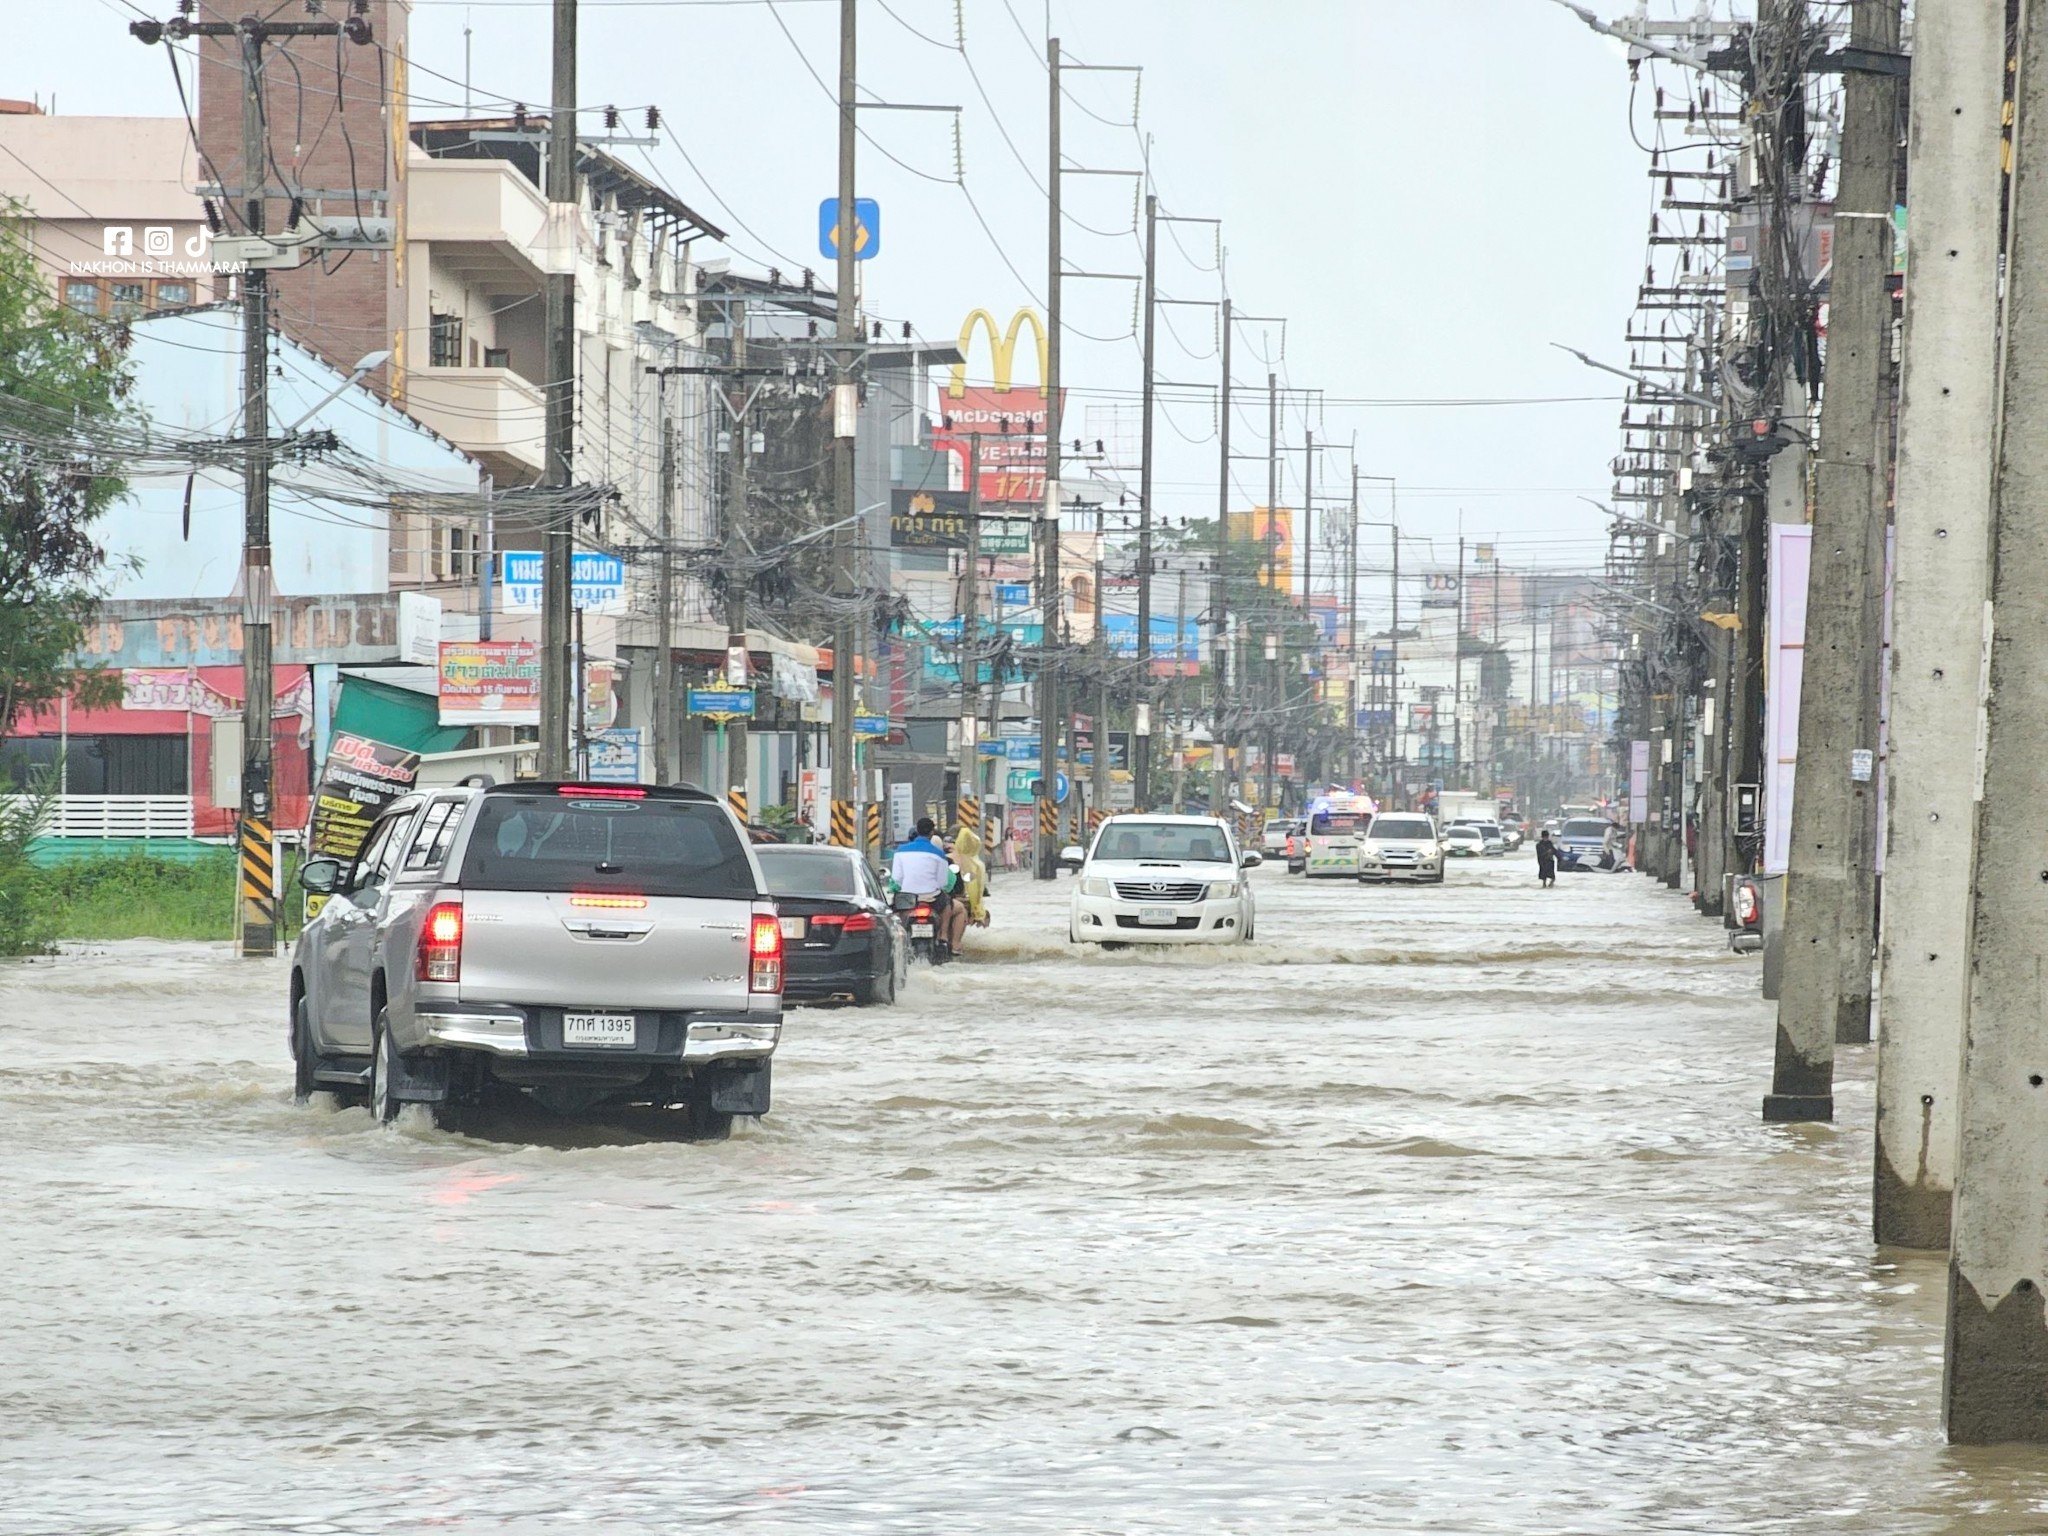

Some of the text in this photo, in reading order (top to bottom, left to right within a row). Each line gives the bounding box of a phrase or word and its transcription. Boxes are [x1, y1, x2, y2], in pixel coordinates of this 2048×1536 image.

[947, 409, 1048, 423] McDonald'
[995, 476, 1047, 498] 1711
[334, 736, 375, 759] เปิด
[567, 1017, 632, 1032] 7กศ 1395
